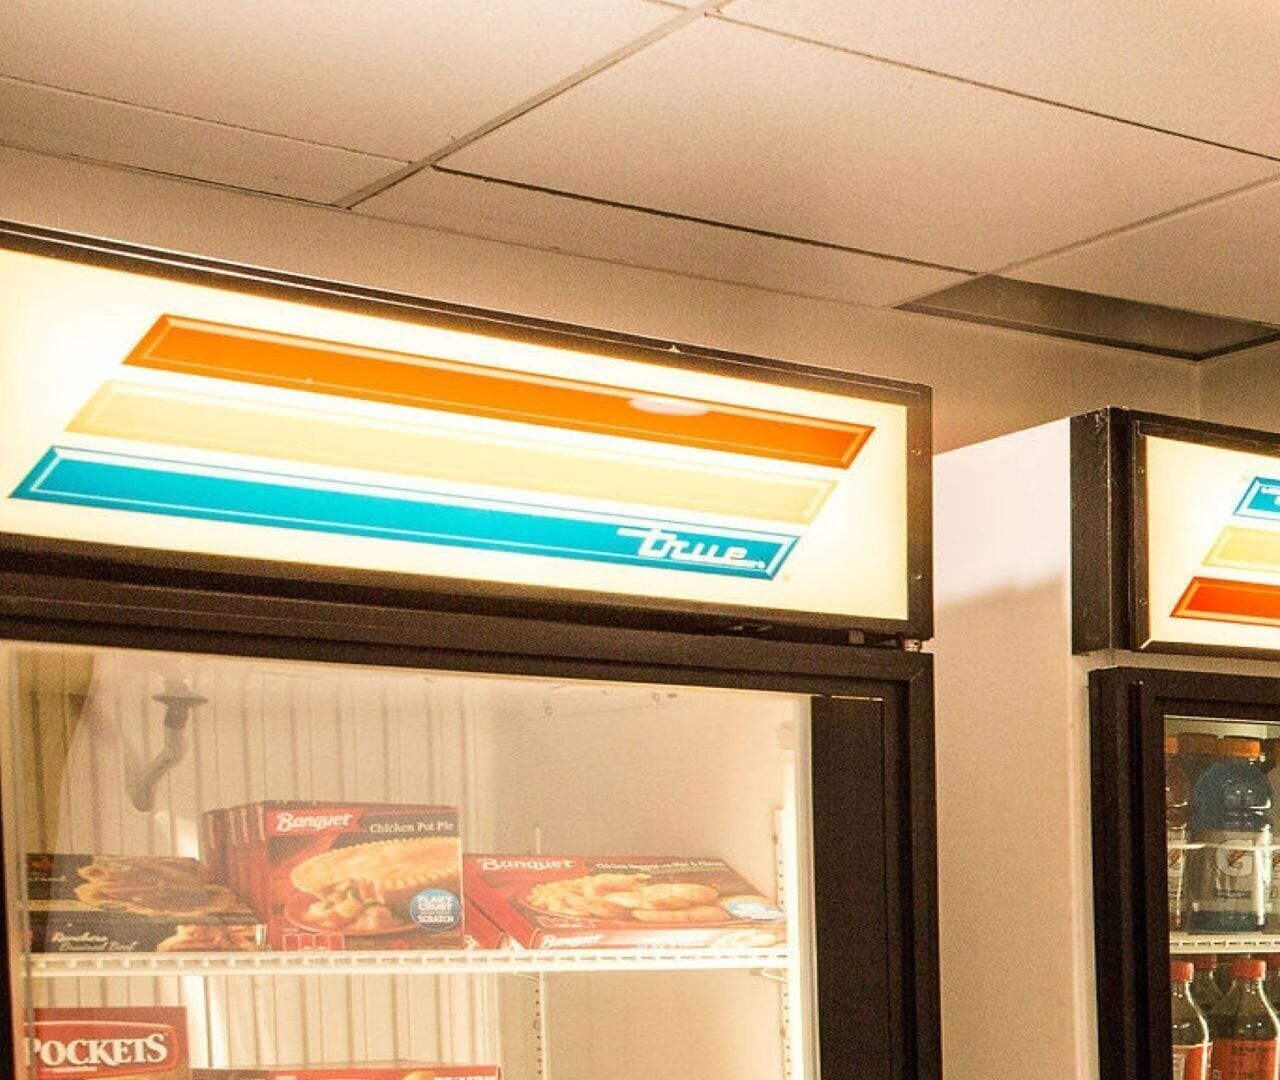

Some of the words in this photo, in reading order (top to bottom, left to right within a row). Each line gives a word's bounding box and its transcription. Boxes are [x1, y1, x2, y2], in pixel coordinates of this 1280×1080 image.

[275, 810, 355, 832] Banquet
[370, 822, 415, 834] Chicken
[417, 821, 435, 833] Pot
[437, 821, 455, 832] Pie
[476, 857, 575, 872] Banquet
